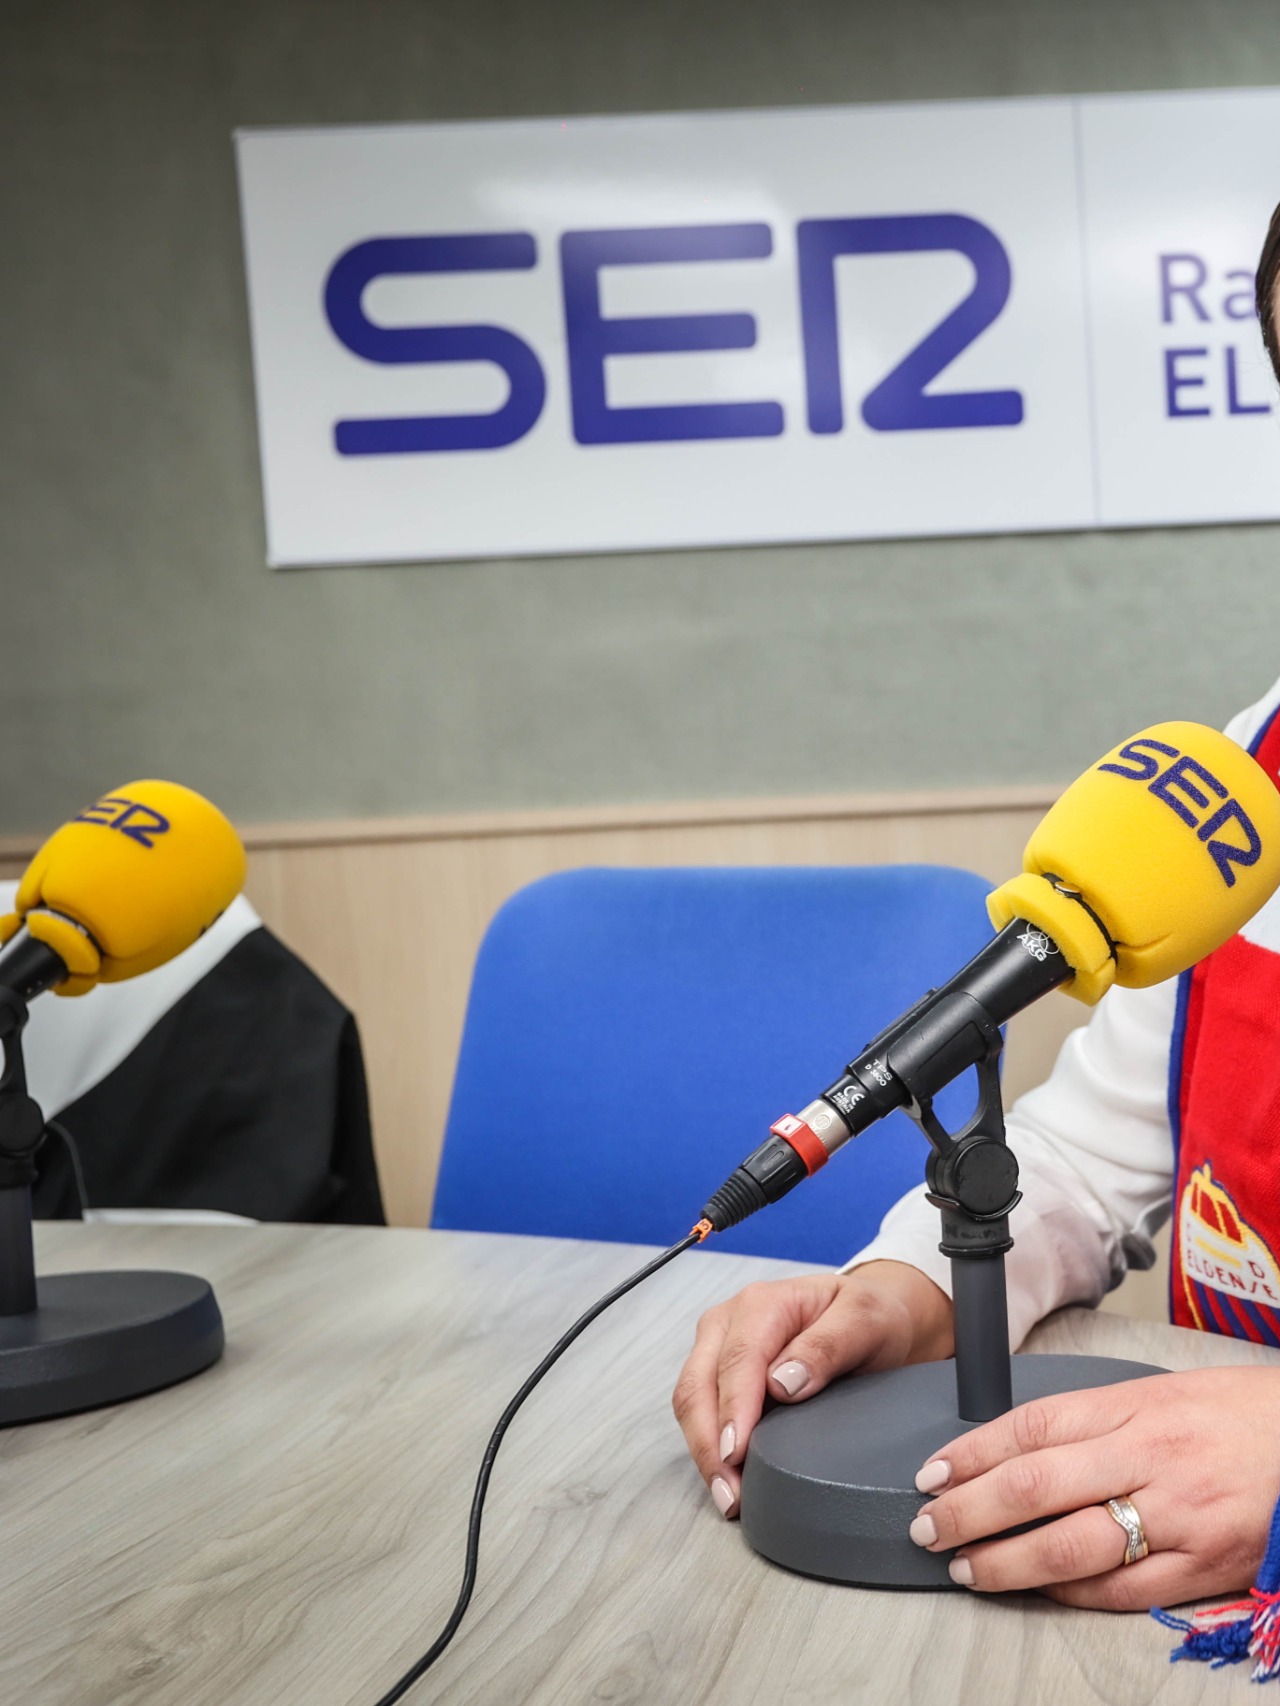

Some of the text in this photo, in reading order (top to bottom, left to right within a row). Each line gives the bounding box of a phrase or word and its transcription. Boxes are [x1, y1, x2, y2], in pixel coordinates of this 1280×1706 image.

[323, 212, 1025, 457] SER
[1164, 344, 1272, 419] EL
[75, 797, 171, 850] ER
[1097, 738, 1262, 889] SER
[1016, 933, 1048, 962] AKG
[843, 1085, 865, 1106] CE
[873, 1059, 893, 1081] TPS
